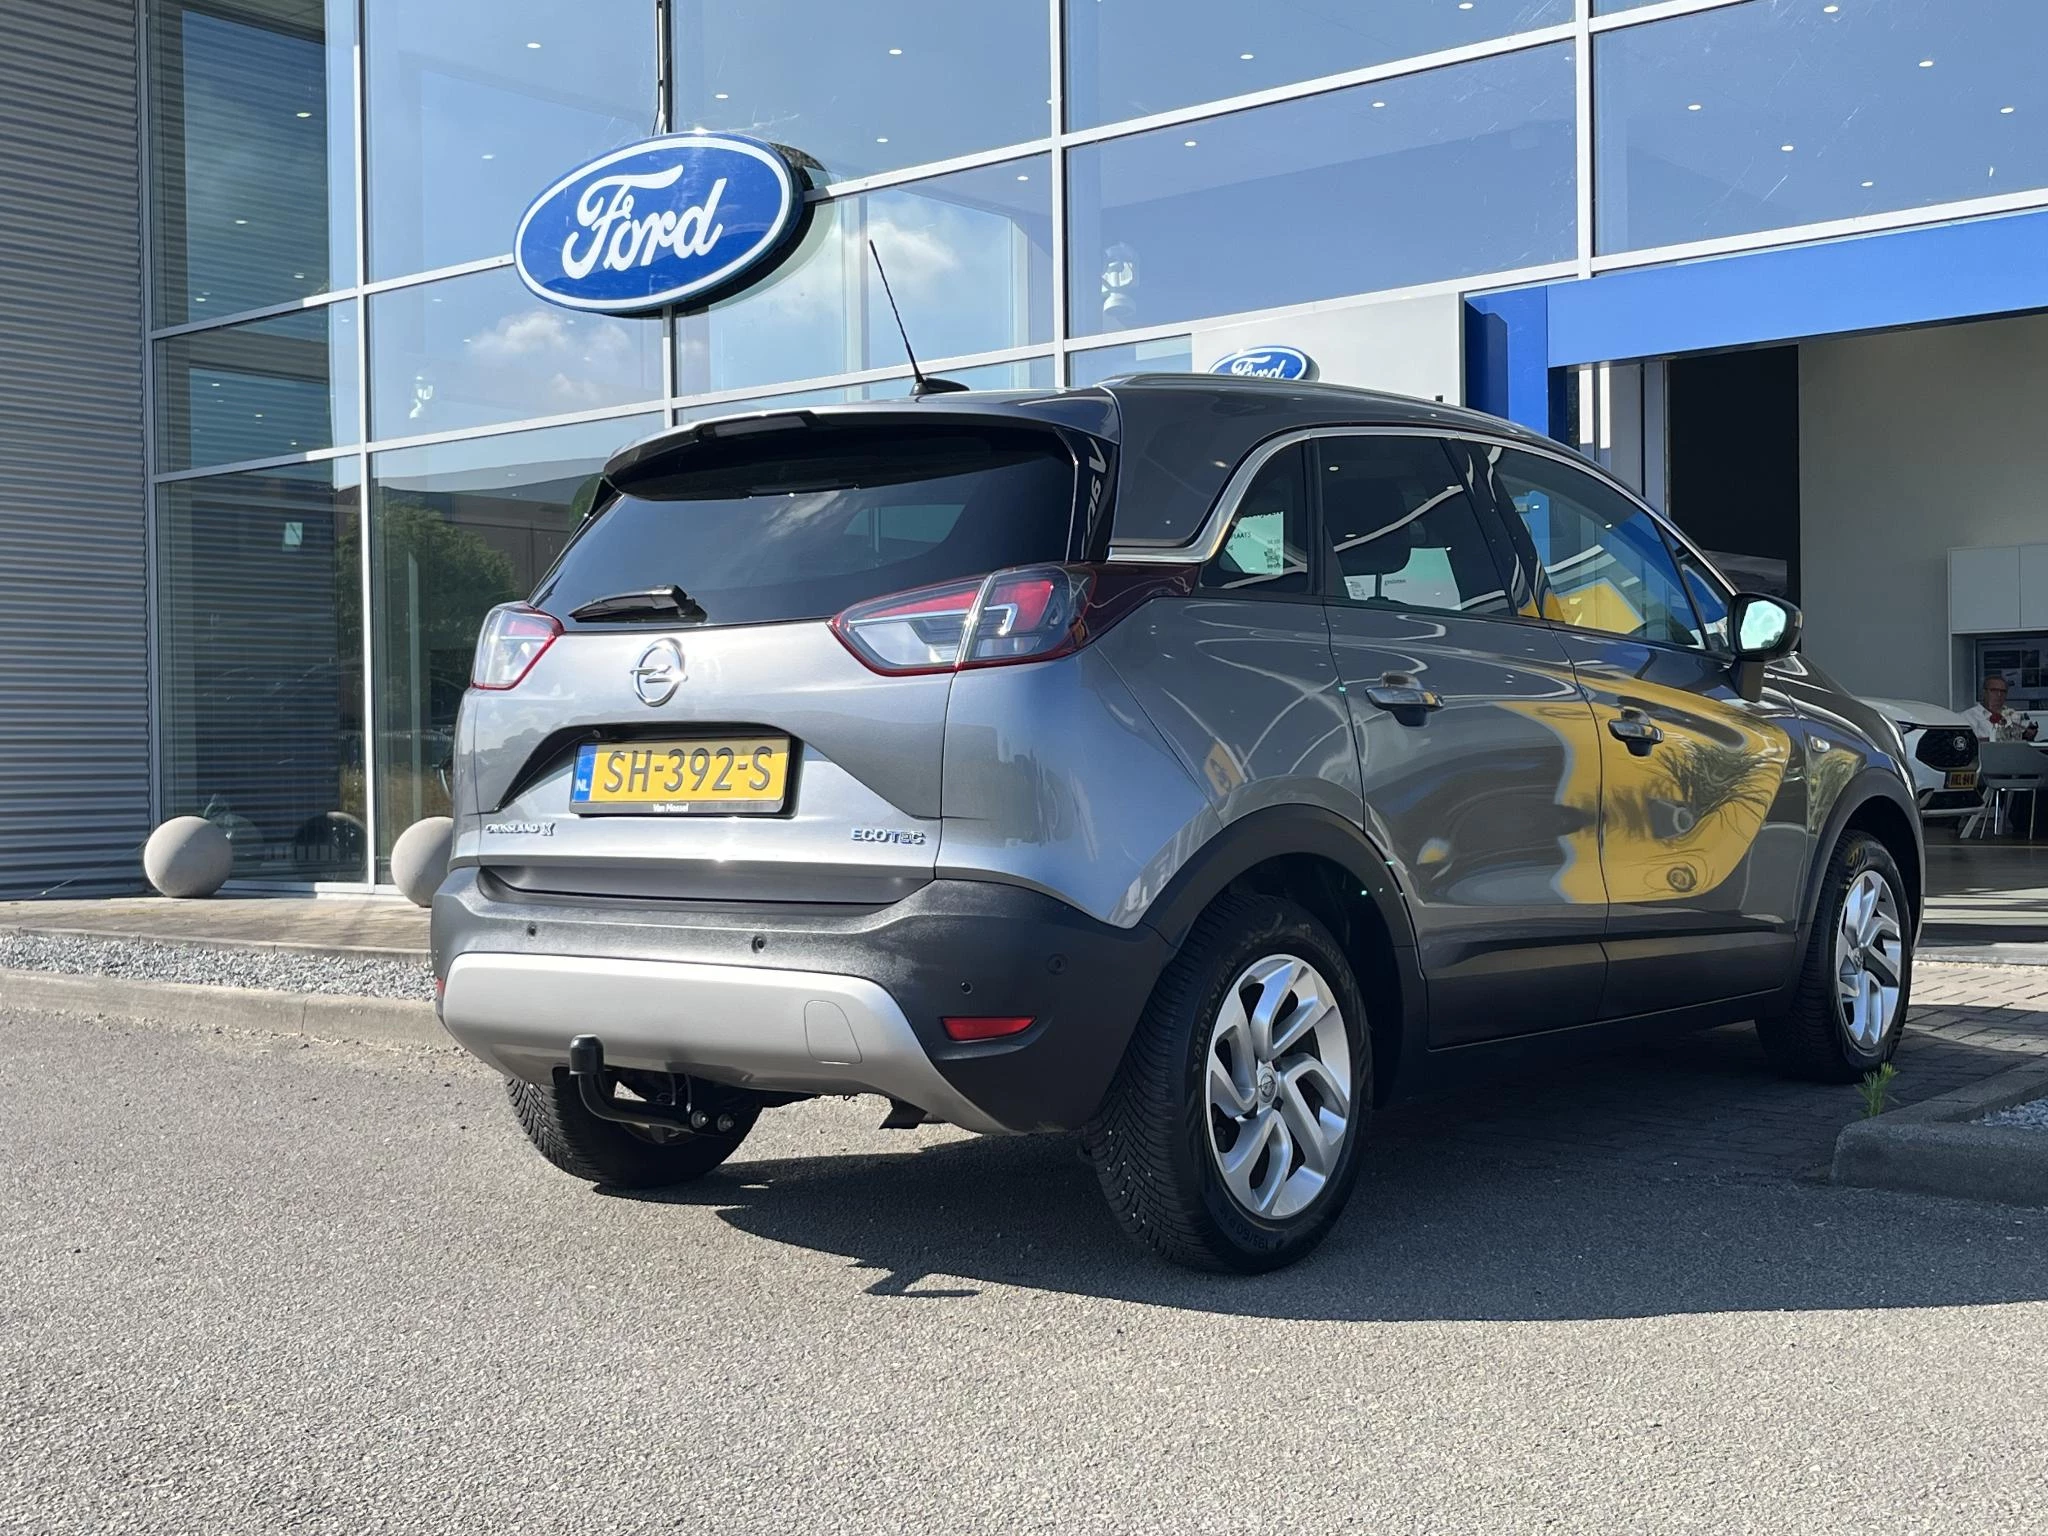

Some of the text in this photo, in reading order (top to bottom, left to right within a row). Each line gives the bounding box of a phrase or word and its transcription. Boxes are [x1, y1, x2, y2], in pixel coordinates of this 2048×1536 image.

[562, 164, 727, 279] Ford
[1231, 355, 1287, 378] Fd
[604, 746, 773, 793] SH-392-S
[576, 779, 589, 792] NL
[541, 822, 556, 836] X
[851, 828, 926, 845] ECOTEC
